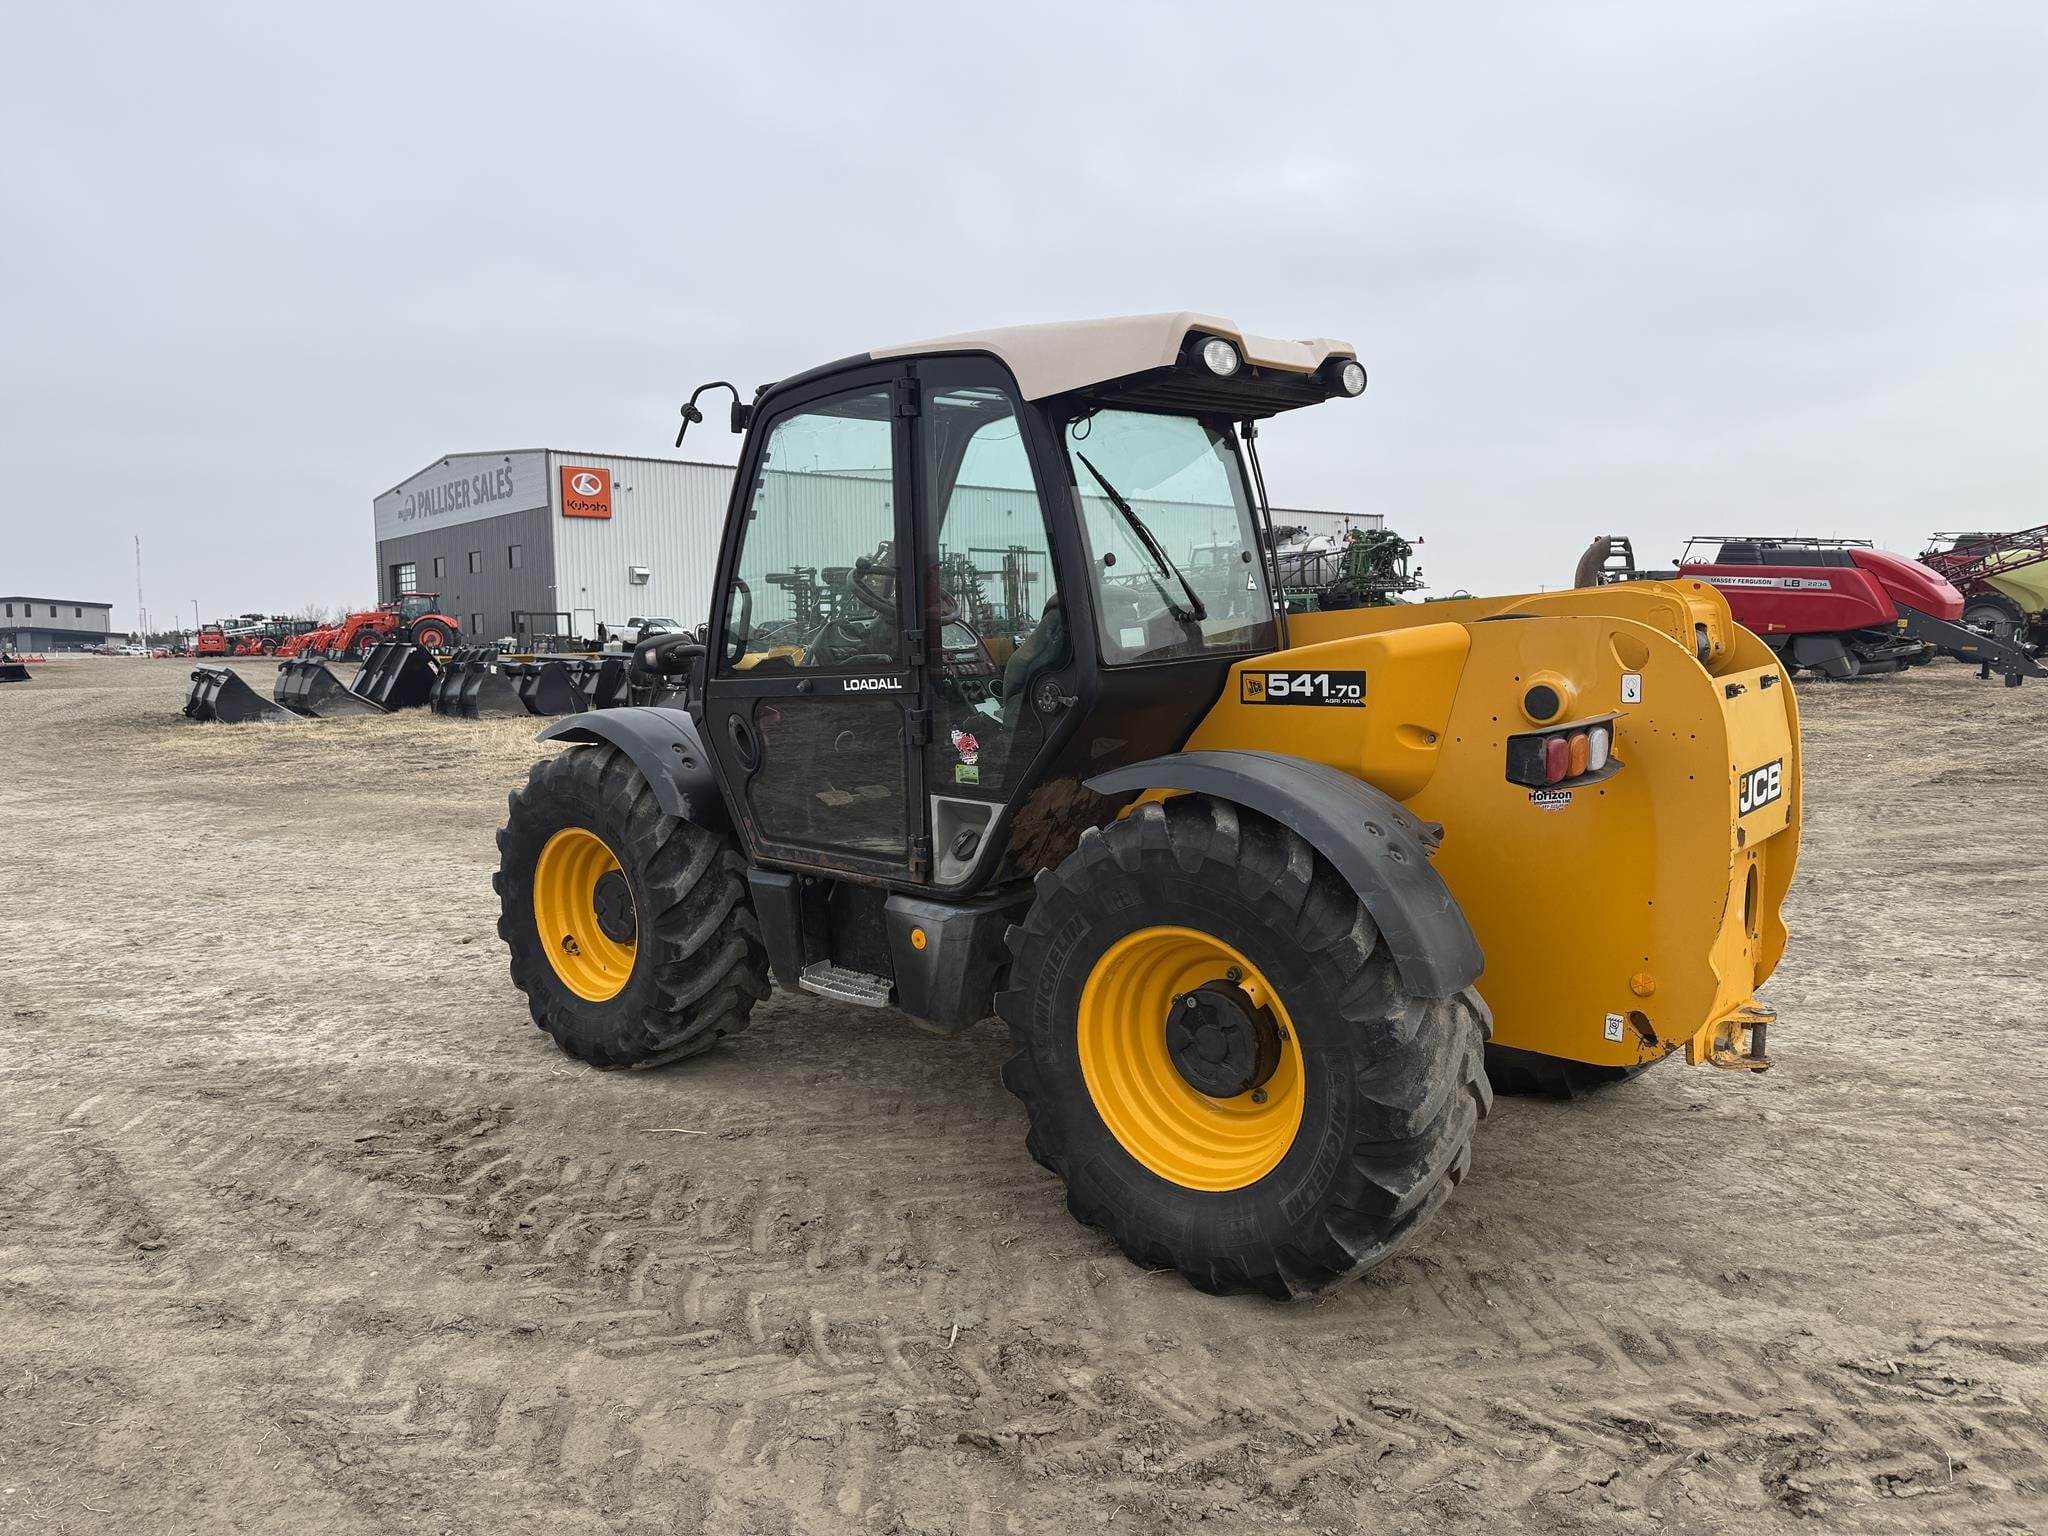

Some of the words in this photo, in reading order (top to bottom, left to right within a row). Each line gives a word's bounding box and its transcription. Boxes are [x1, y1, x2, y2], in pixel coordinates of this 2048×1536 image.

[417, 479, 470, 519] PALLISER
[472, 465, 514, 506] SALES
[567, 499, 608, 512] Kubota
[1784, 579, 1801, 588] LB
[843, 677, 903, 691] LOADALL
[1740, 762, 1781, 813] JCB
[1528, 790, 1572, 801] Horizon
